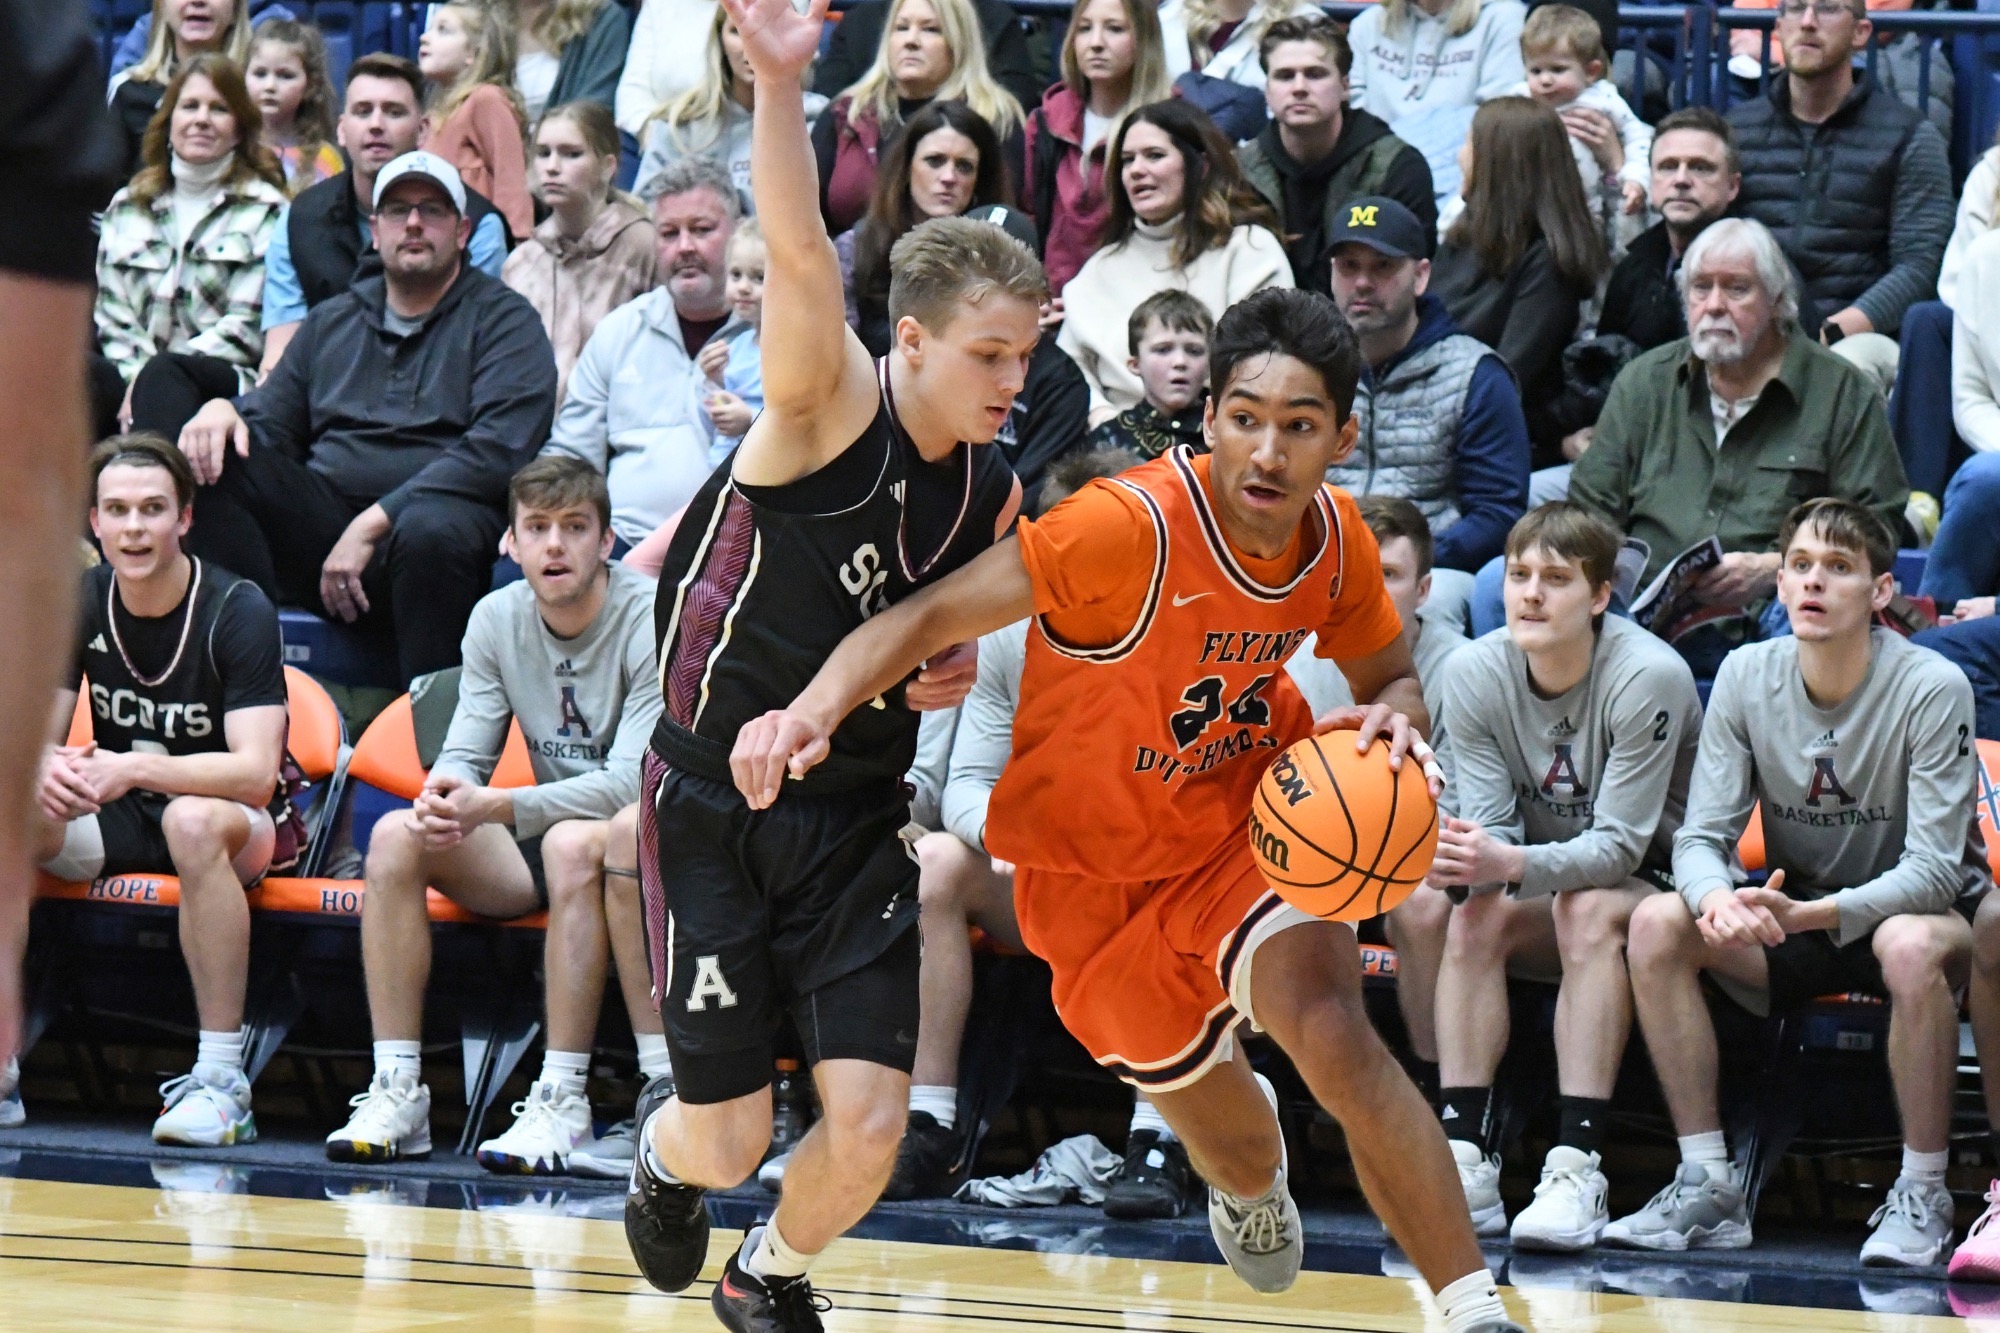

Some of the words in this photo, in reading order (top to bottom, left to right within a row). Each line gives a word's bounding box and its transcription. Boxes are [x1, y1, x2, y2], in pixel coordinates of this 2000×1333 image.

[1347, 205, 1379, 228] M
[1198, 627, 1307, 665] FLYING
[91, 682, 213, 739] SCOTS
[556, 686, 592, 738] A
[1653, 710, 1669, 741] 2
[1957, 723, 1970, 756] 2
[1541, 744, 1589, 797] A
[1805, 756, 1857, 808] A
[88, 877, 162, 902] HOPE
[320, 889, 365, 914] HO
[685, 954, 738, 1012] A
